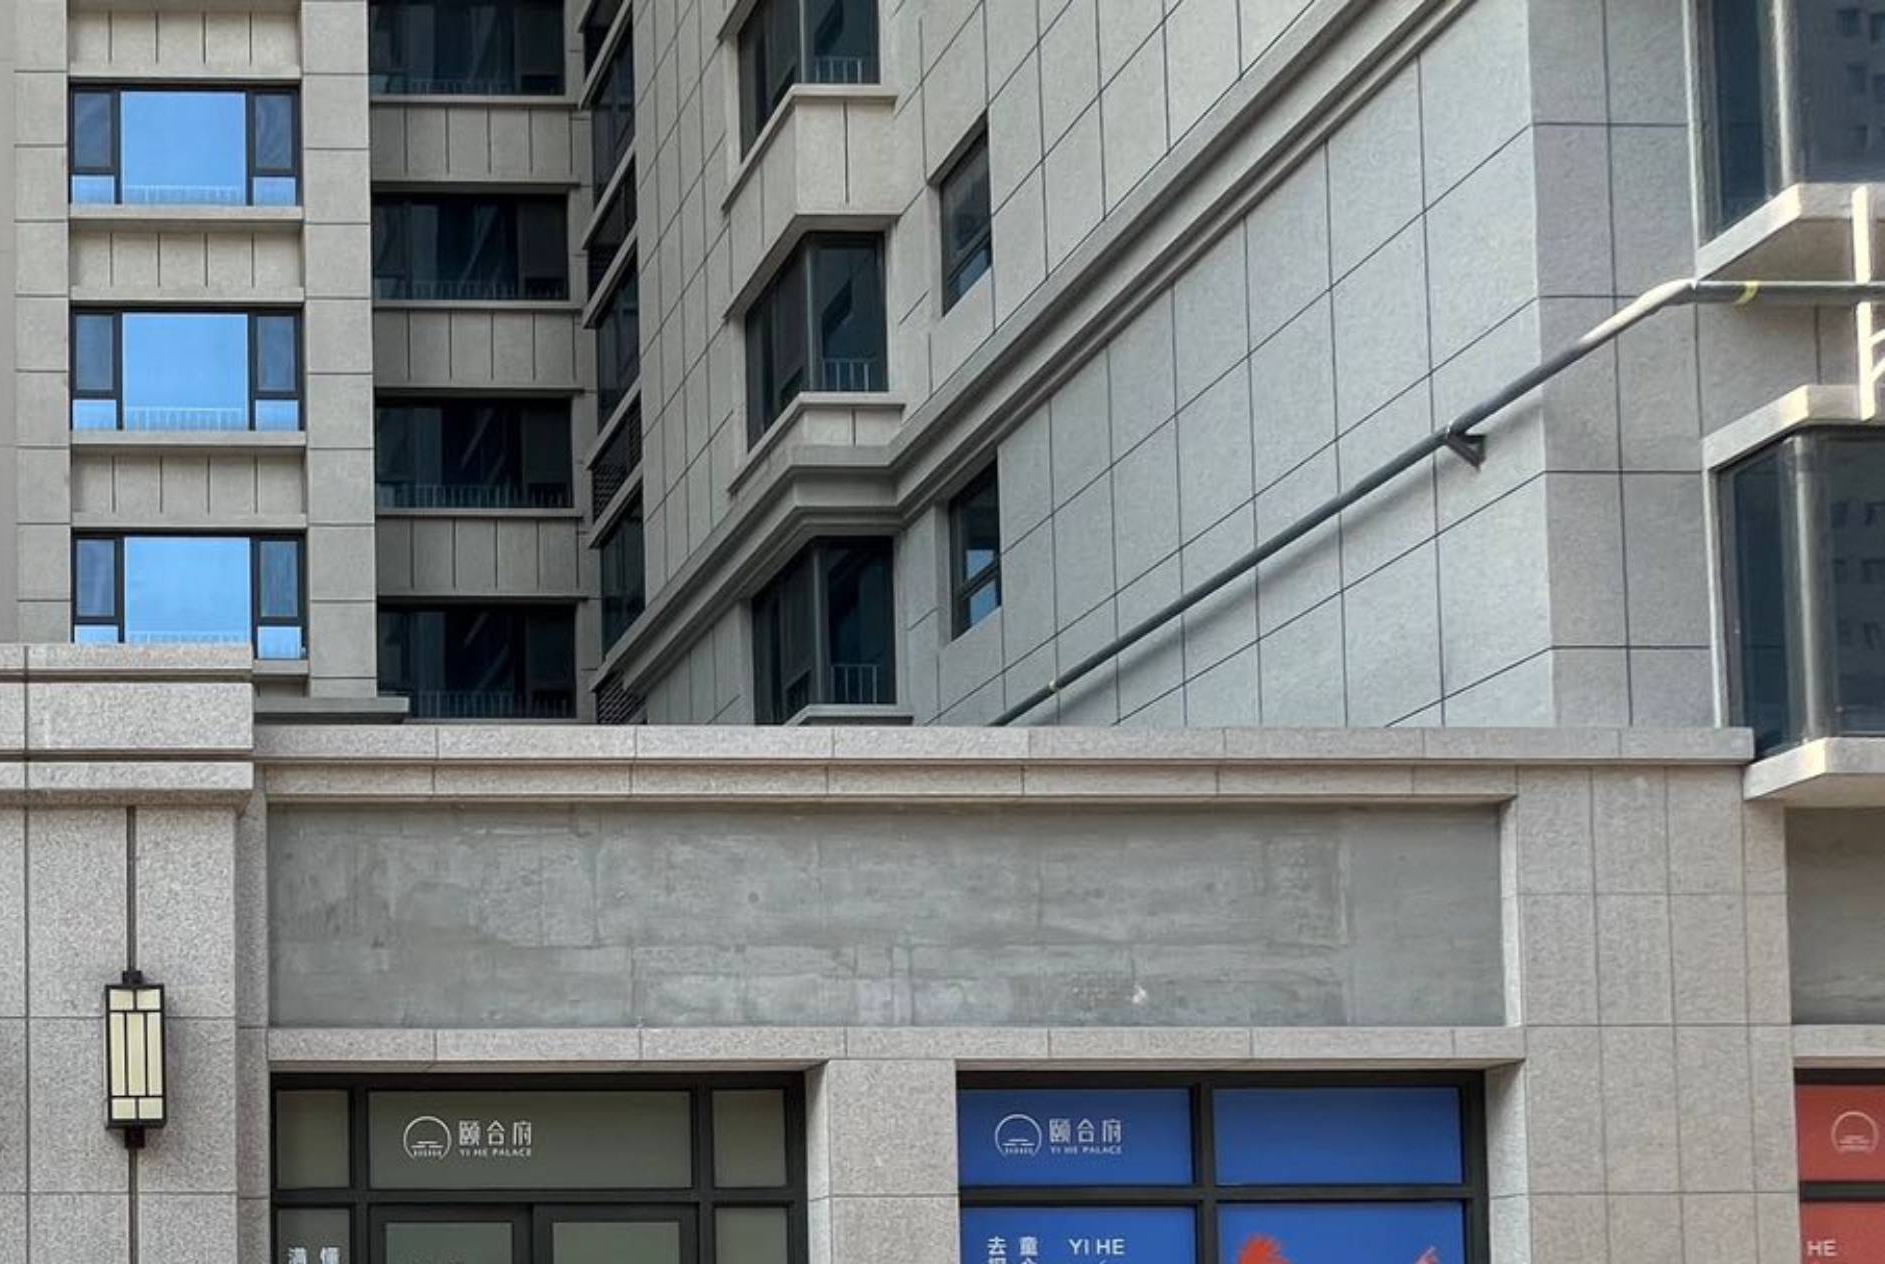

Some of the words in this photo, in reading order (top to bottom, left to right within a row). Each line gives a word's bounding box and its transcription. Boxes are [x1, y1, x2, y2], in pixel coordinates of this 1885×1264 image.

[1069, 1238, 1089, 1255] YI
[1096, 1238, 1125, 1255] HE
[1806, 1239, 1838, 1257] HE
